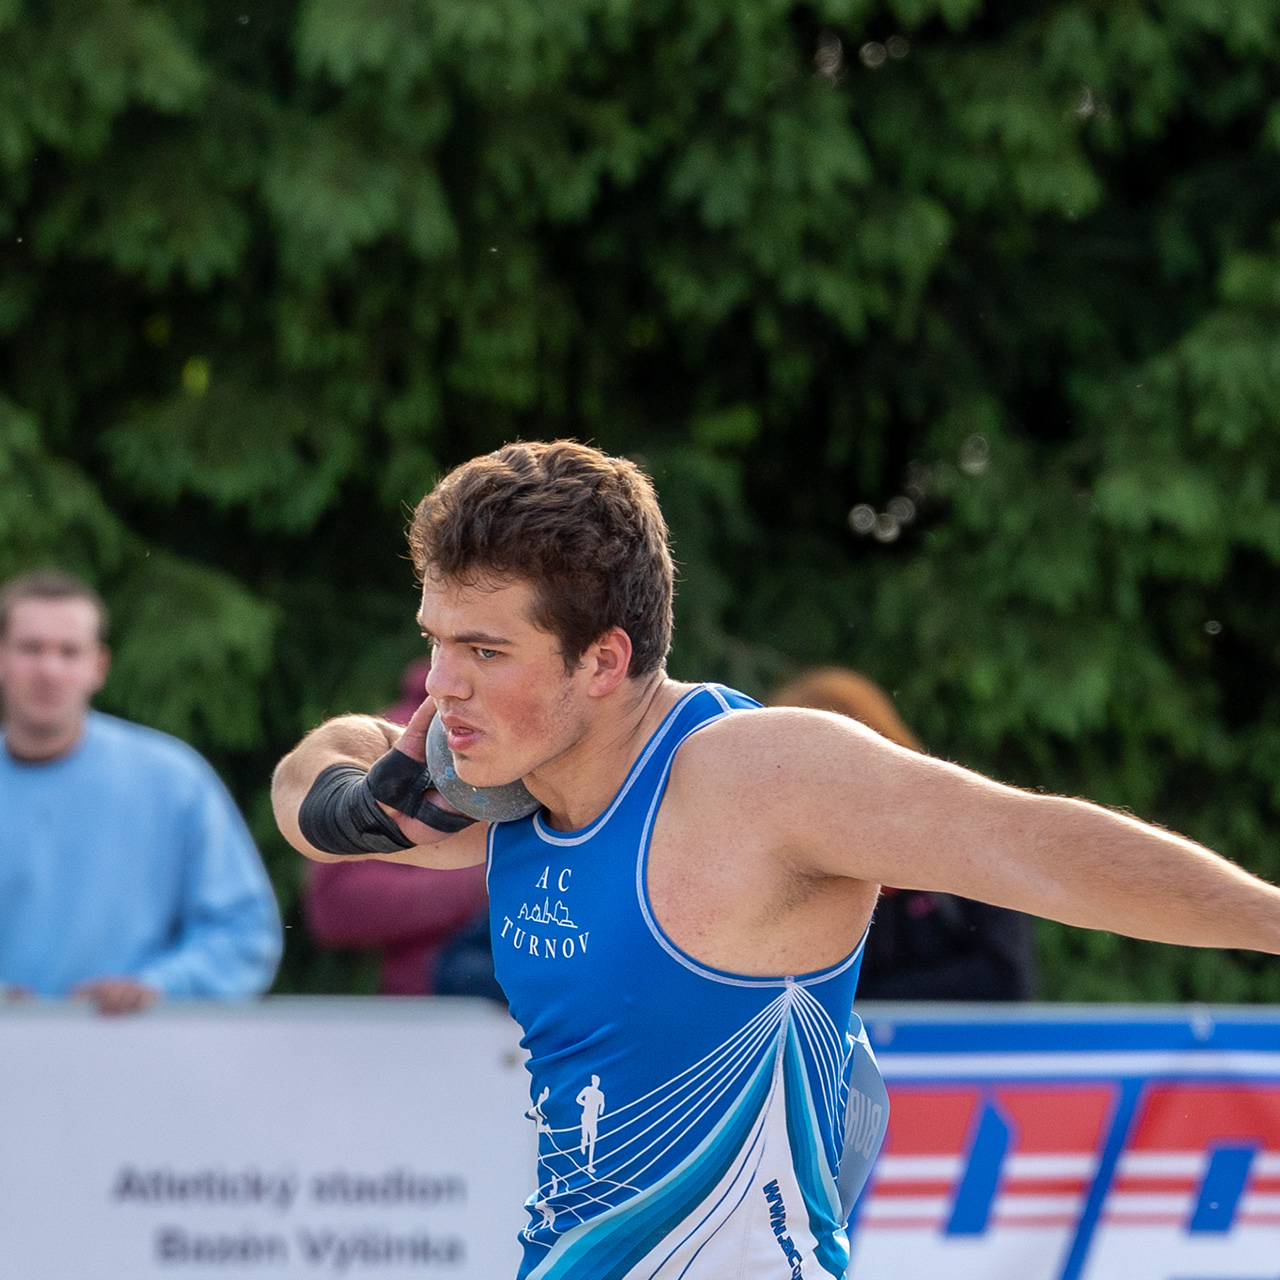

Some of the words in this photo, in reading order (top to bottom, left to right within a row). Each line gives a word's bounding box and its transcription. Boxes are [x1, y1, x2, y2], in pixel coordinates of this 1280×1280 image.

[501, 916, 589, 959] TURNOV
[113, 1165, 298, 1215] Atletický
[313, 1166, 467, 1205] stadion
[154, 1222, 289, 1265] Bazén
[296, 1222, 466, 1276] Výšinka
